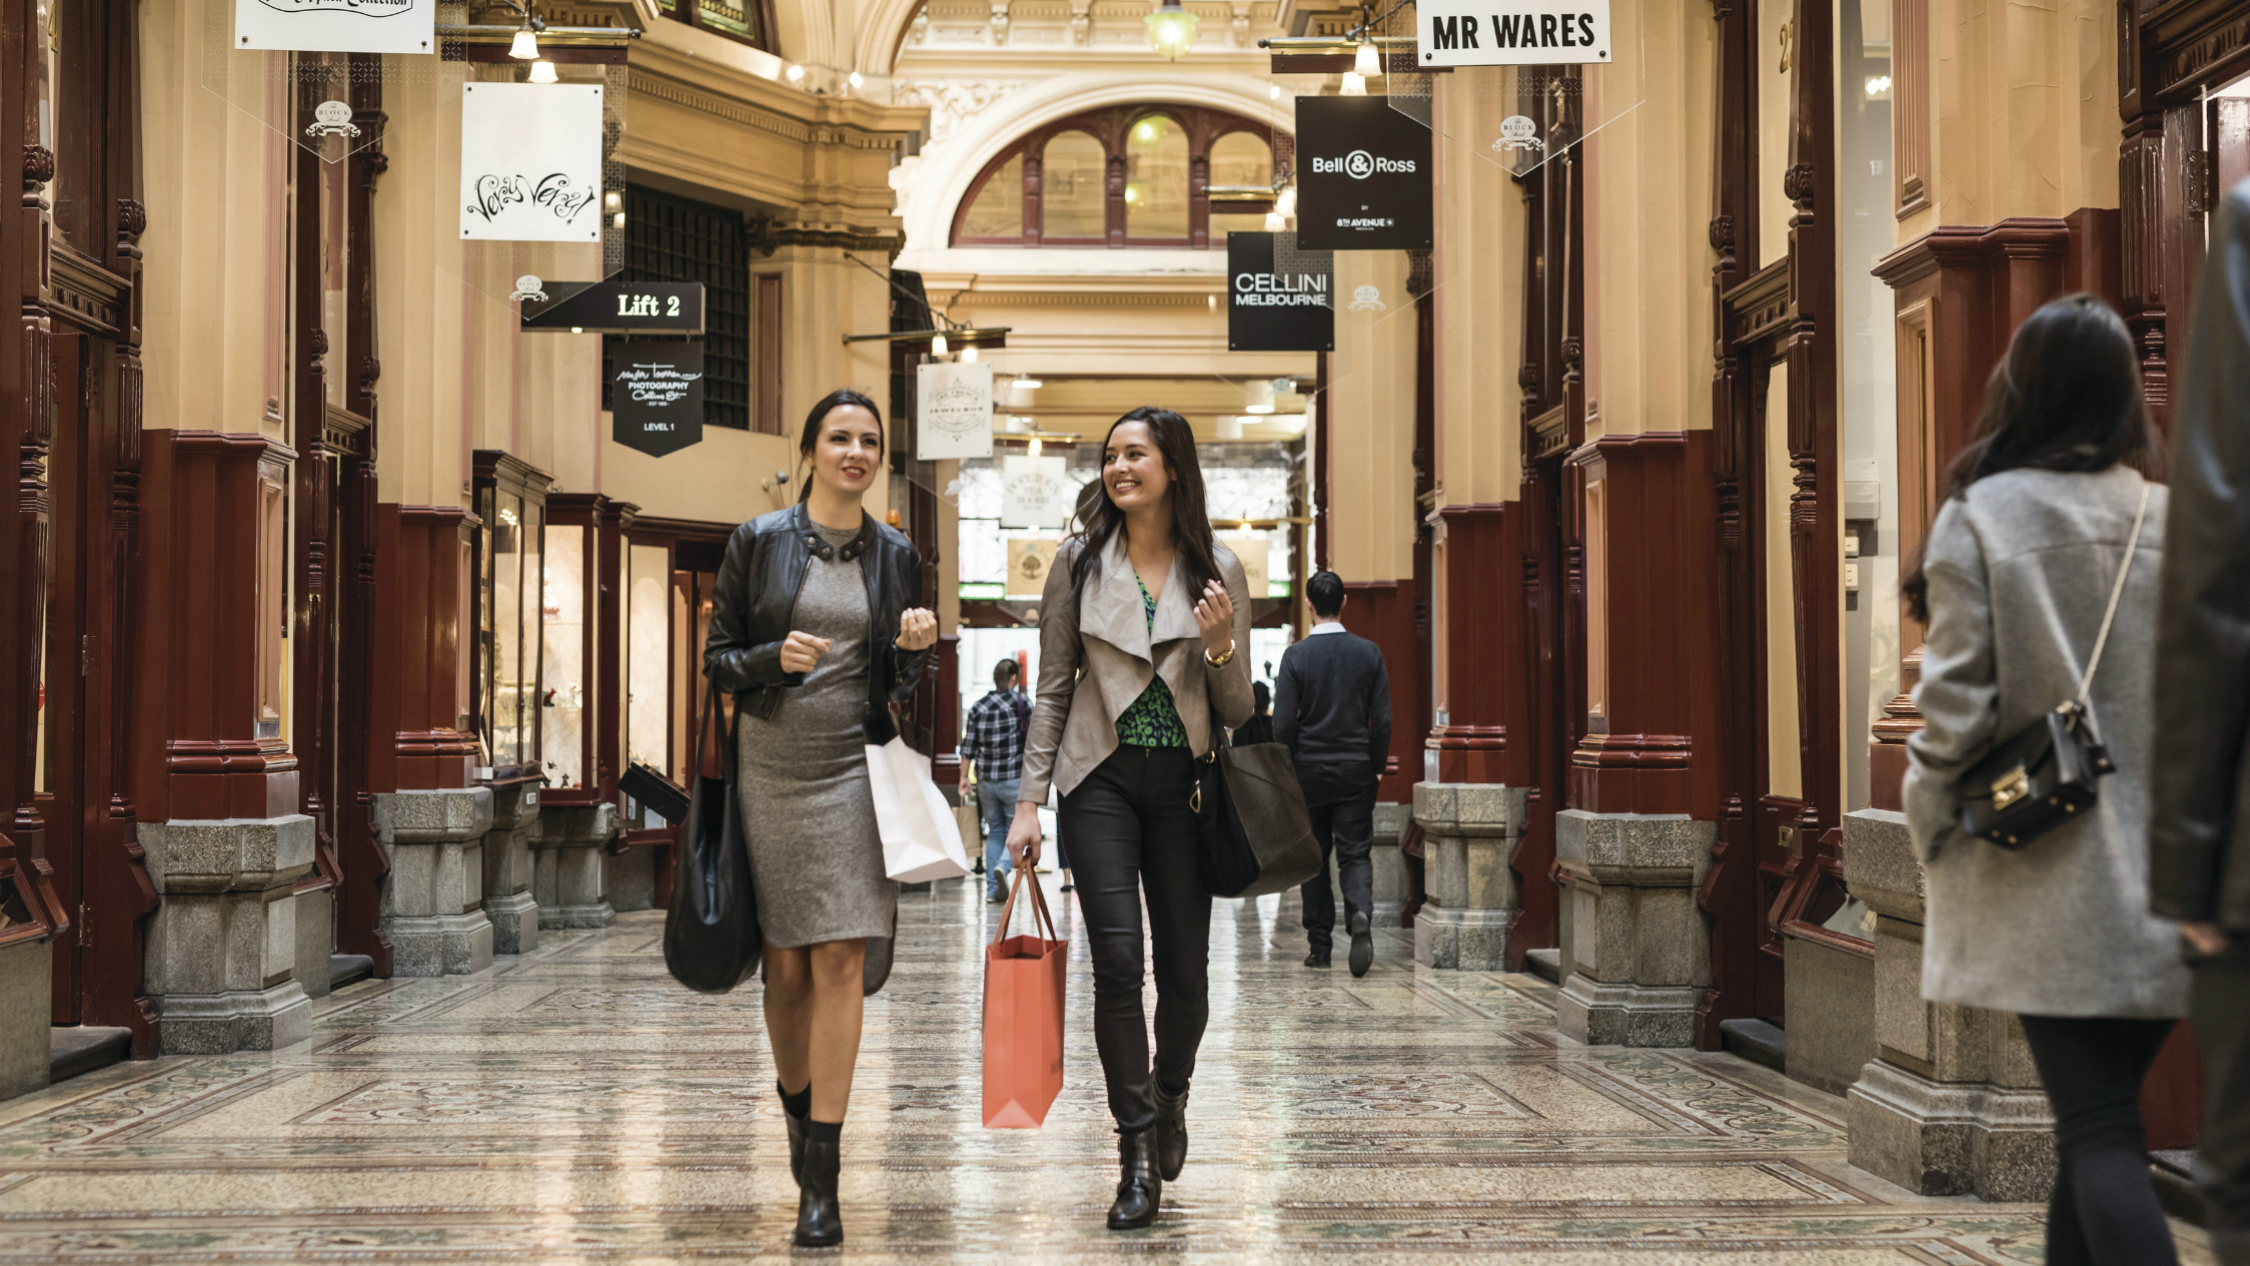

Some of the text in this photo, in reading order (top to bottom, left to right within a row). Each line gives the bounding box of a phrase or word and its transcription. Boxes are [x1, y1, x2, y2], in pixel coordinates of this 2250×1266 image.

[1433, 13, 1595, 50] MR WARES
[1312, 157, 1343, 173] Bell
[1376, 157, 1416, 173] Ross
[466, 174, 524, 224] Very
[1350, 218, 1386, 227] AVENUE
[1235, 273, 1327, 293] CELLINI
[617, 294, 680, 316] Lift 2
[1235, 293, 1326, 306] MELBOURNE
[628, 381, 689, 390] PHOTOGRAPHY
[644, 423, 675, 431] LEVEL 1
